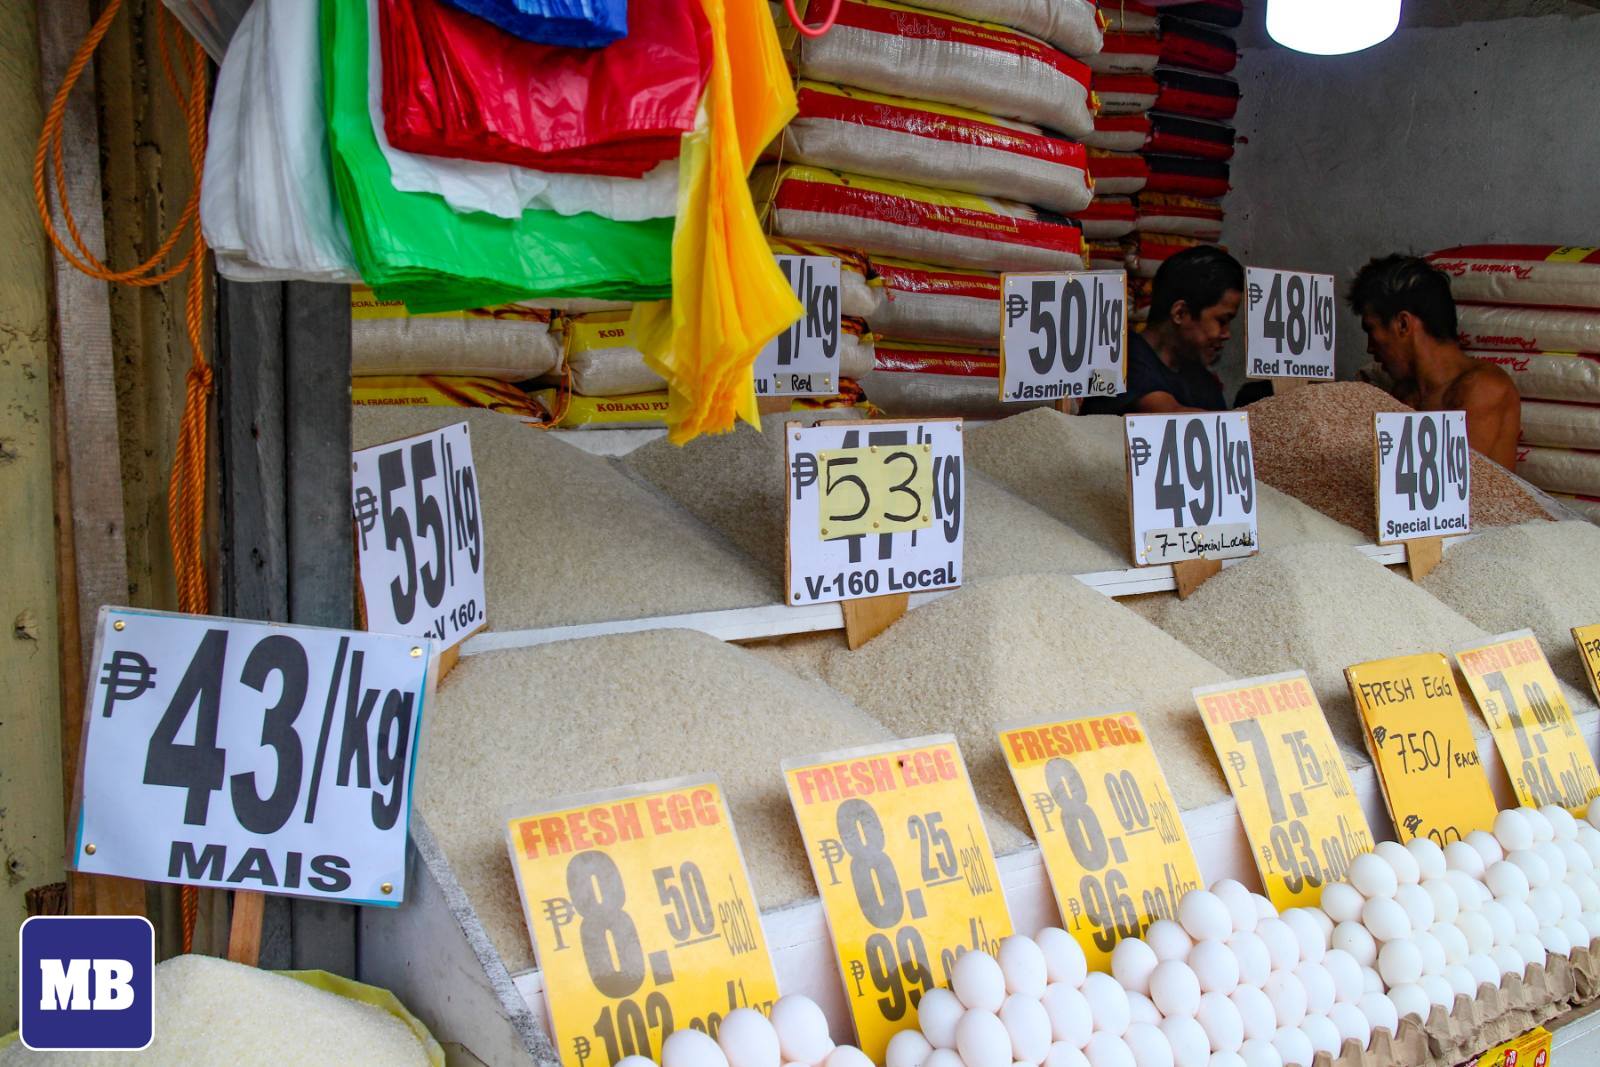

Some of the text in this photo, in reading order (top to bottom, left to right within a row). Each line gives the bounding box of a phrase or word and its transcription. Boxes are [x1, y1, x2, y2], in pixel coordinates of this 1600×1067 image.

[791, 374, 812, 392] Red
[1254, 359, 1279, 374] Red
[368, 397, 410, 406] FRAGRANT
[596, 402, 650, 412] KOHAKU
[1012, 380, 1082, 399] Jasmine
[1387, 517, 1430, 537] Special
[805, 561, 955, 600] V-160 Local
[1460, 640, 1541, 677] FRESH EGG
[1204, 681, 1312, 725] FRESH EGG
[1359, 676, 1453, 710] FRESH EGG
[1006, 716, 1142, 764] FRESH EGG
[796, 749, 958, 804] FRESH EGG
[518, 789, 720, 860] FRESH EGG
[168, 841, 351, 892] MAIS
